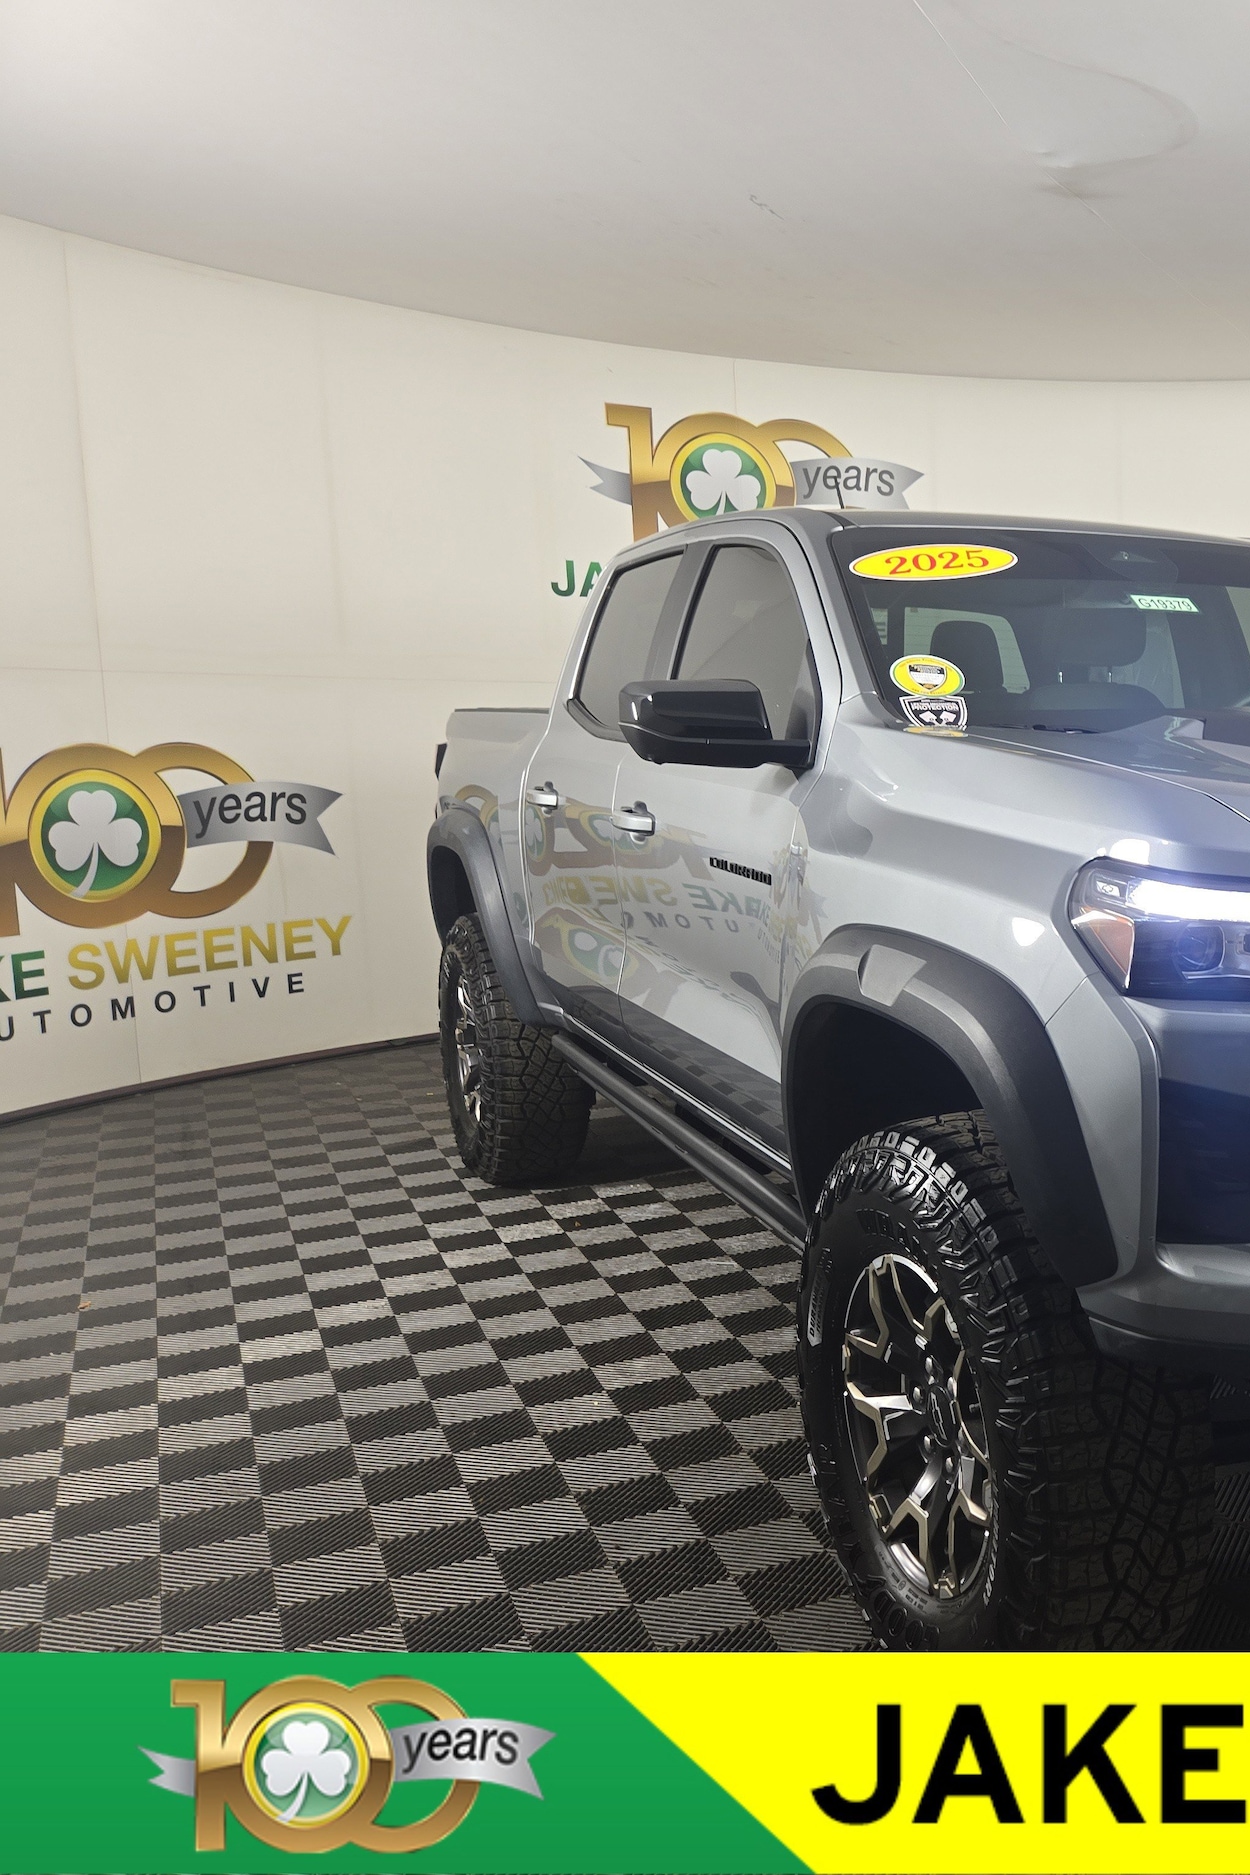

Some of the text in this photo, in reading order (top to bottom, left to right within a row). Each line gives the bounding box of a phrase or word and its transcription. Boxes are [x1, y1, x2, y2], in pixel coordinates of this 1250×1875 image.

[802, 465, 896, 498] years
[884, 549, 990, 576] 2025
[192, 790, 308, 839] years
[67, 915, 353, 991] SWEENEY
